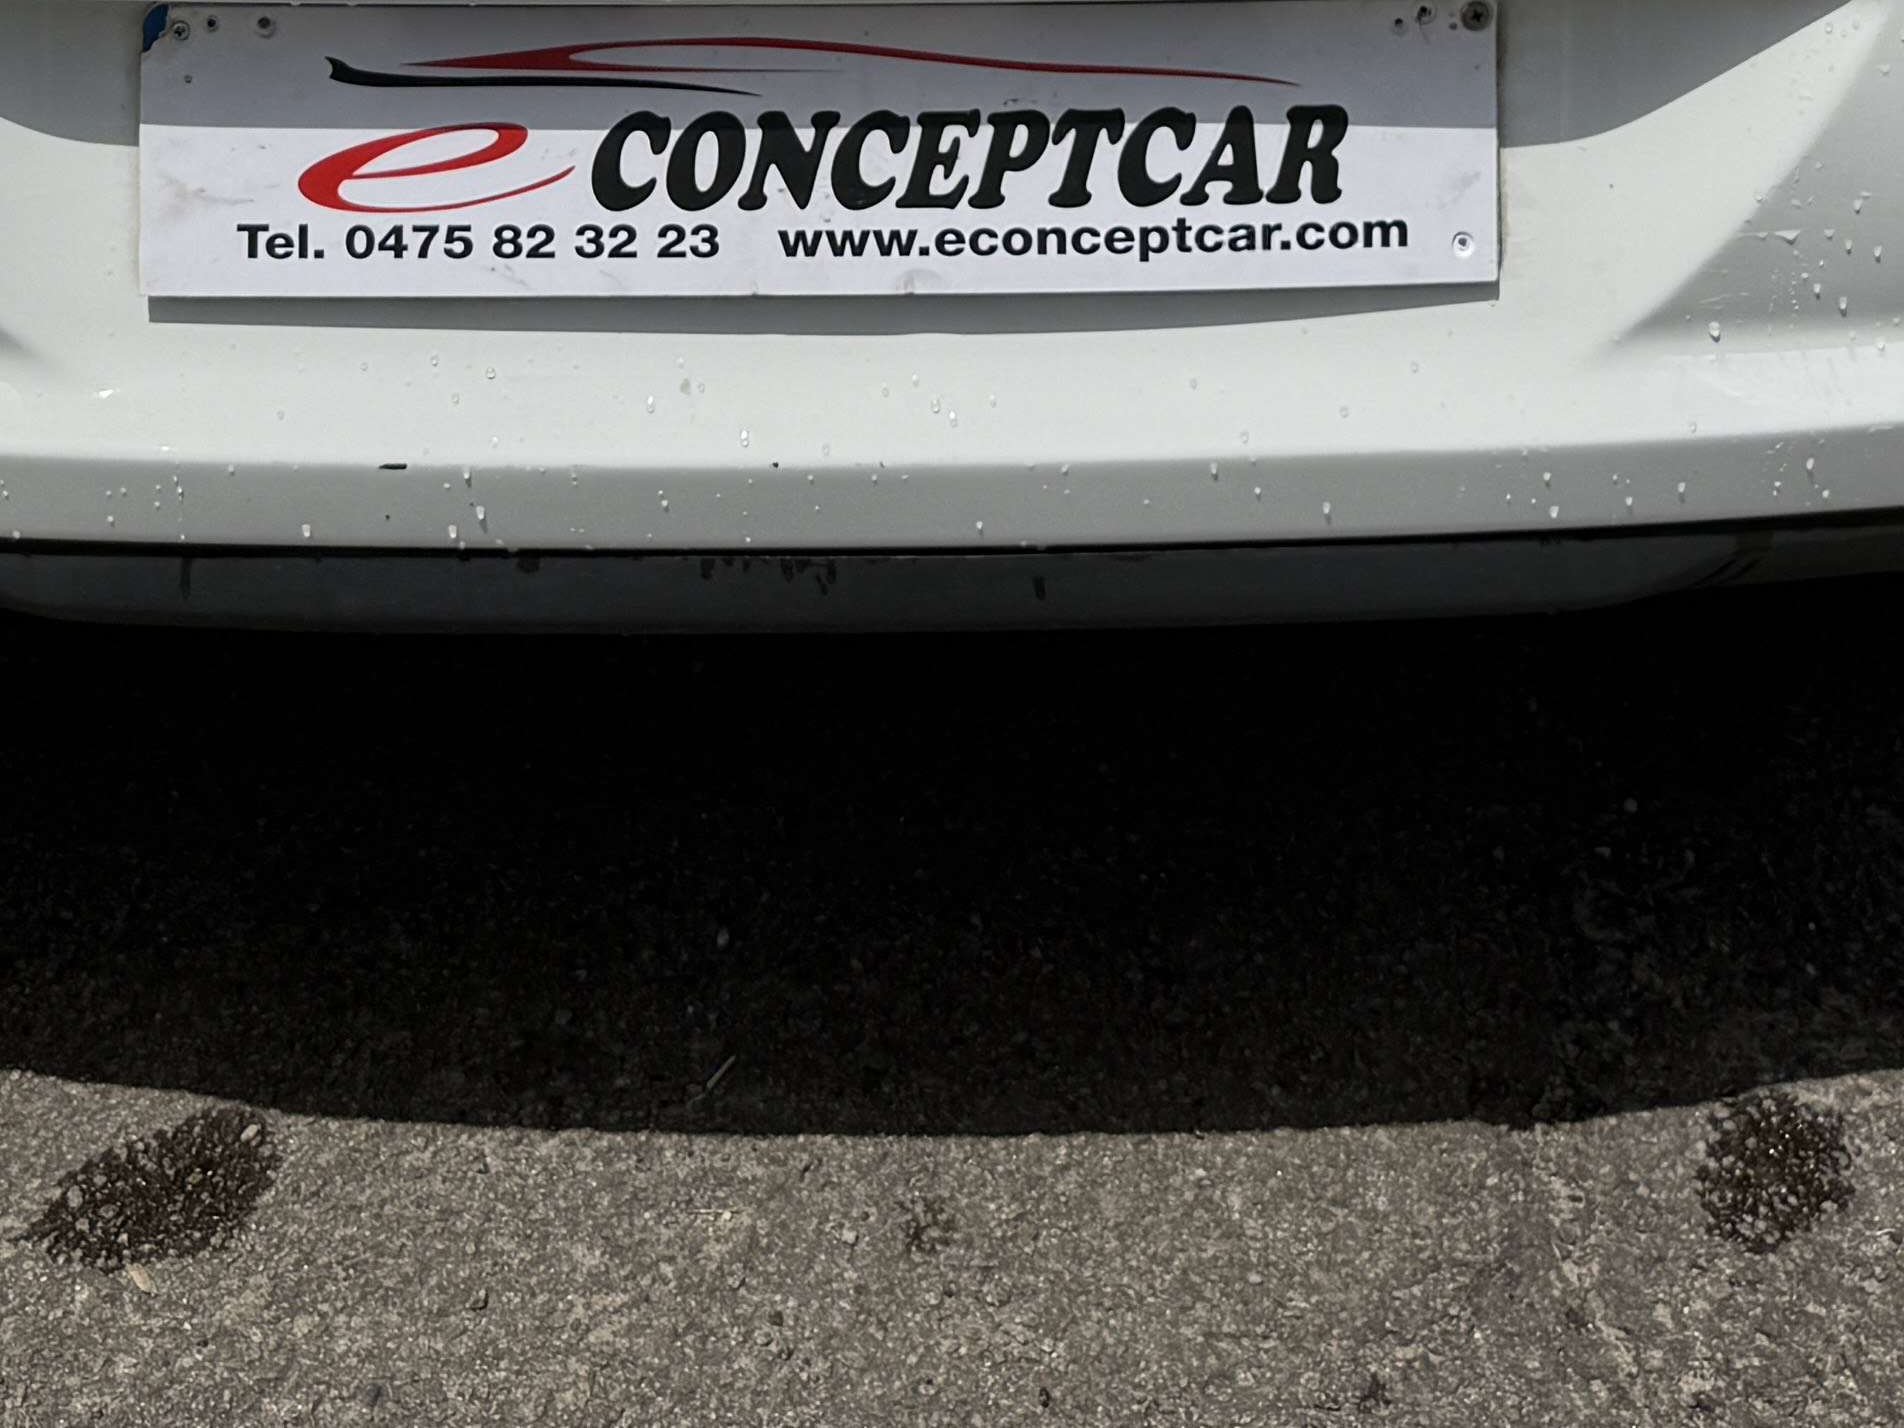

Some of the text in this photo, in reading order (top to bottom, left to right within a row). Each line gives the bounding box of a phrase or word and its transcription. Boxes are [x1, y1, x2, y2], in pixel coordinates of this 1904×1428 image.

[591, 104, 1350, 212] CONCEPTCAR
[236, 218, 1408, 262] Tel. 0475 82 32 23 www.econceptcar.com
